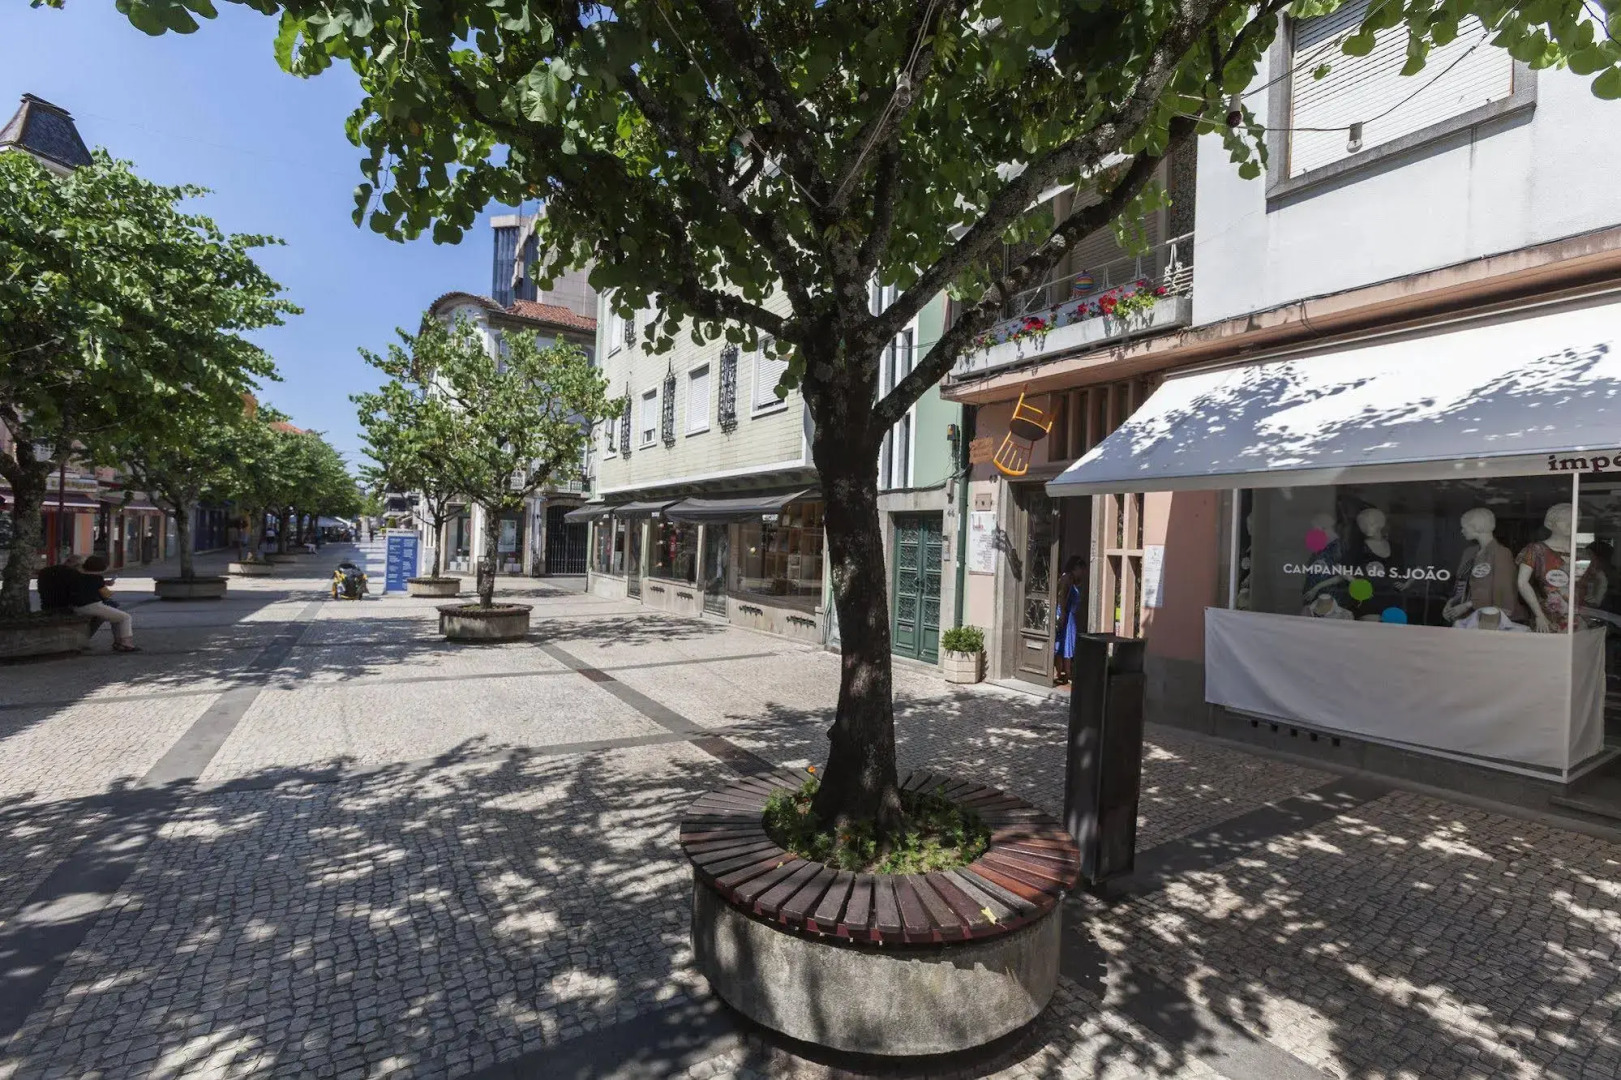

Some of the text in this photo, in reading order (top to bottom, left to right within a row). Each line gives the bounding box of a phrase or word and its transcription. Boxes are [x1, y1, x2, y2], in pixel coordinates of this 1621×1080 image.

[1283, 563, 1451, 581] CAMPANHA de S.JOÃO
